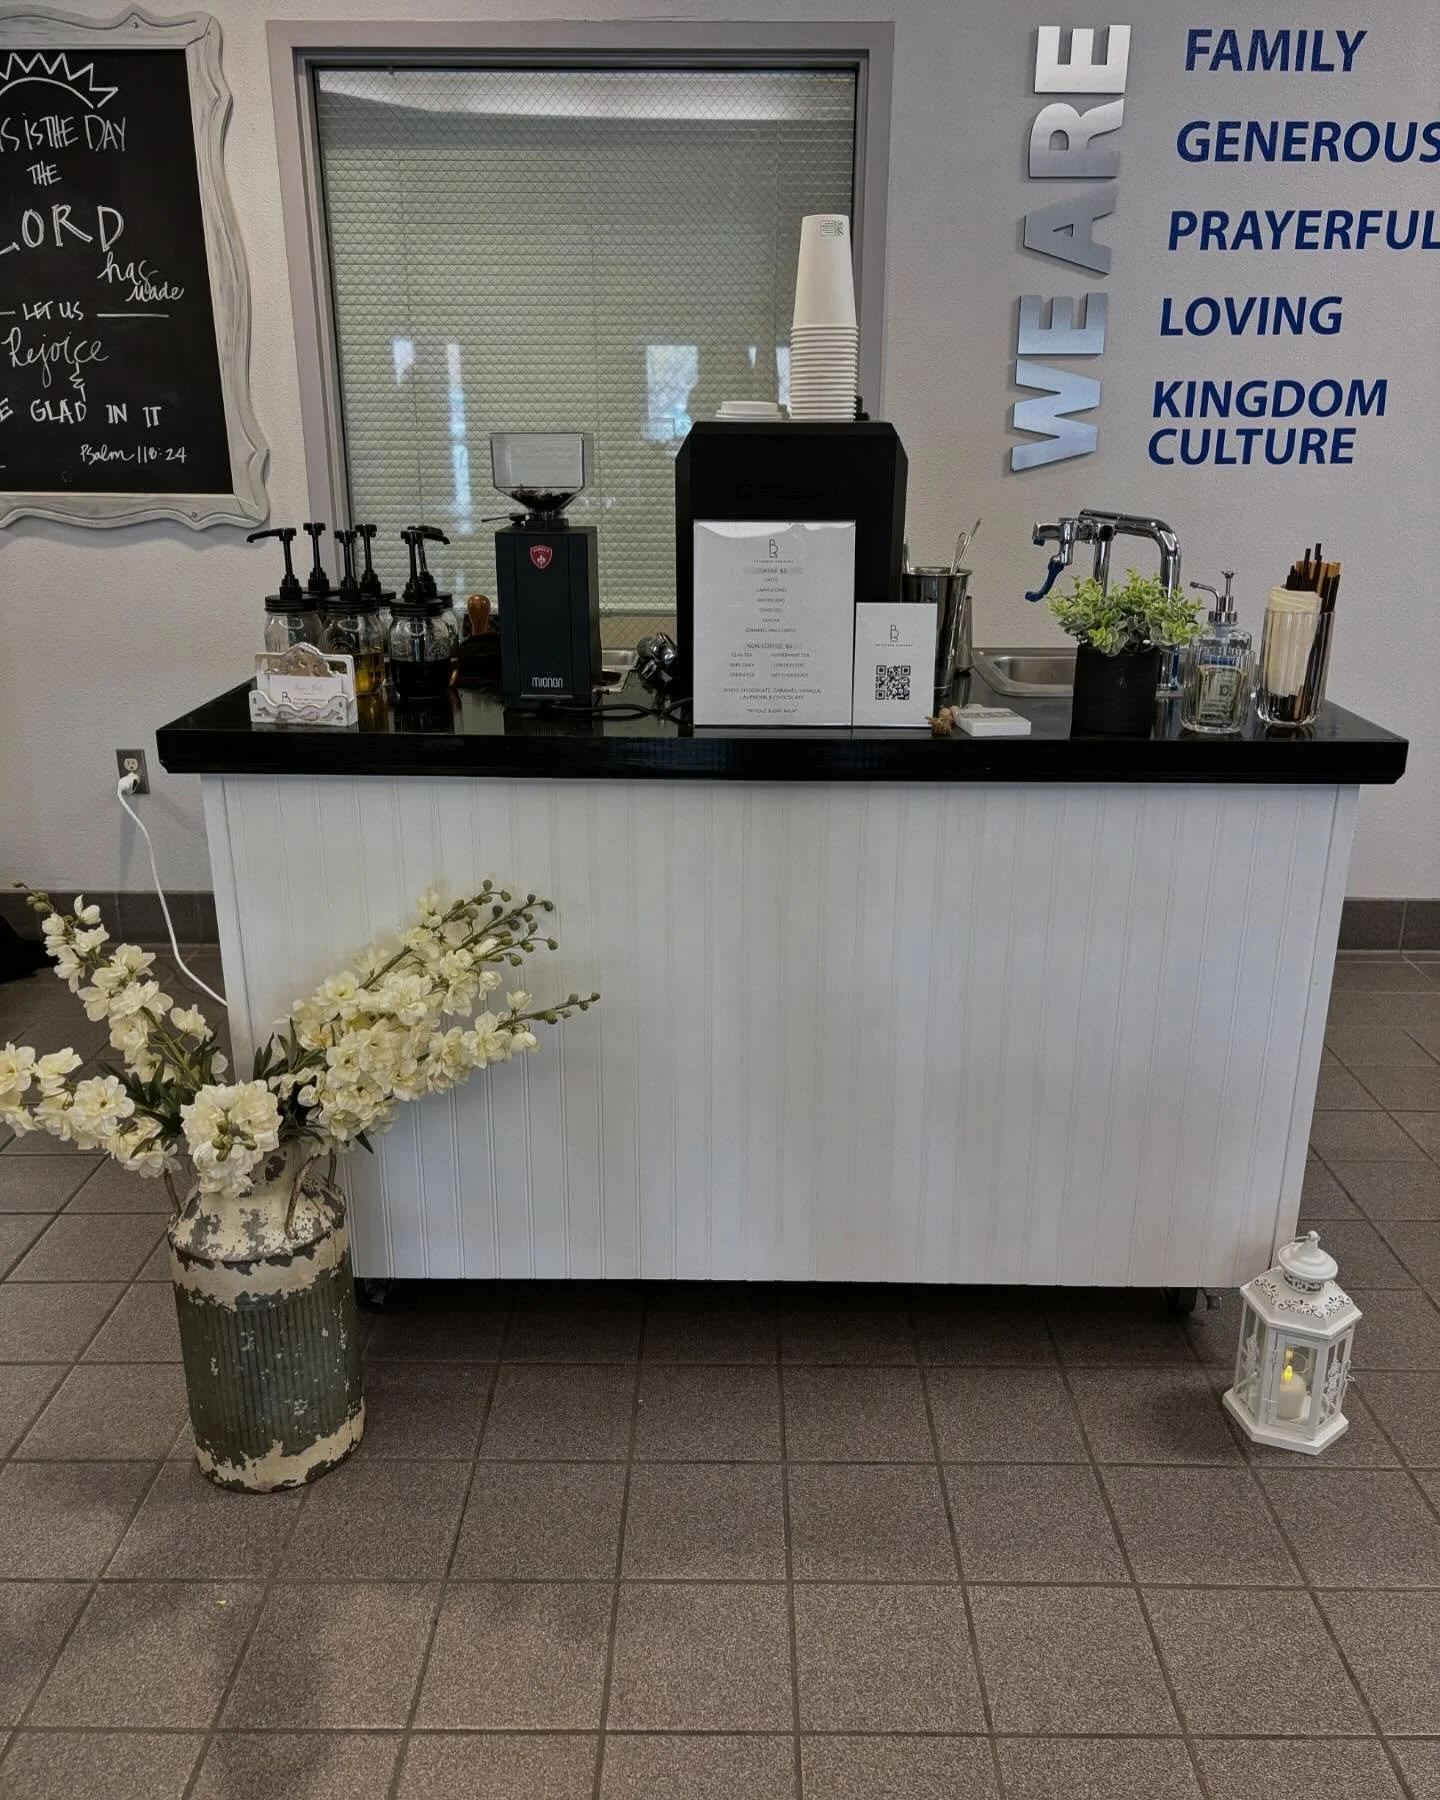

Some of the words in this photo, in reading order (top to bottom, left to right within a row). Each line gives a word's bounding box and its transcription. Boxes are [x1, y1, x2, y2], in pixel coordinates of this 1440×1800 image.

[1187, 29, 1368, 72] FAMILY
[40, 115, 79, 148] THE
[84, 114, 126, 152] DAY
[1023, 24, 1131, 275] ARE
[1176, 121, 1440, 163] GENEROUS
[26, 160, 62, 187] THE
[1168, 210, 1440, 251] PRAYERFUL
[97, 251, 159, 294] has
[126, 281, 185, 302] made
[22, 301, 54, 321] LET
[58, 301, 84, 321] US
[1160, 297, 1343, 336] LOVING
[1, 327, 109, 388] Rejoice
[1011, 292, 1108, 472] WE
[1152, 379, 1388, 418] KINGDOM
[30, 398, 87, 424] GLAD
[106, 402, 128, 424] IN
[142, 406, 162, 428] IT
[80, 443, 136, 466] Psalm
[1148, 427, 1357, 465] CULTURE
